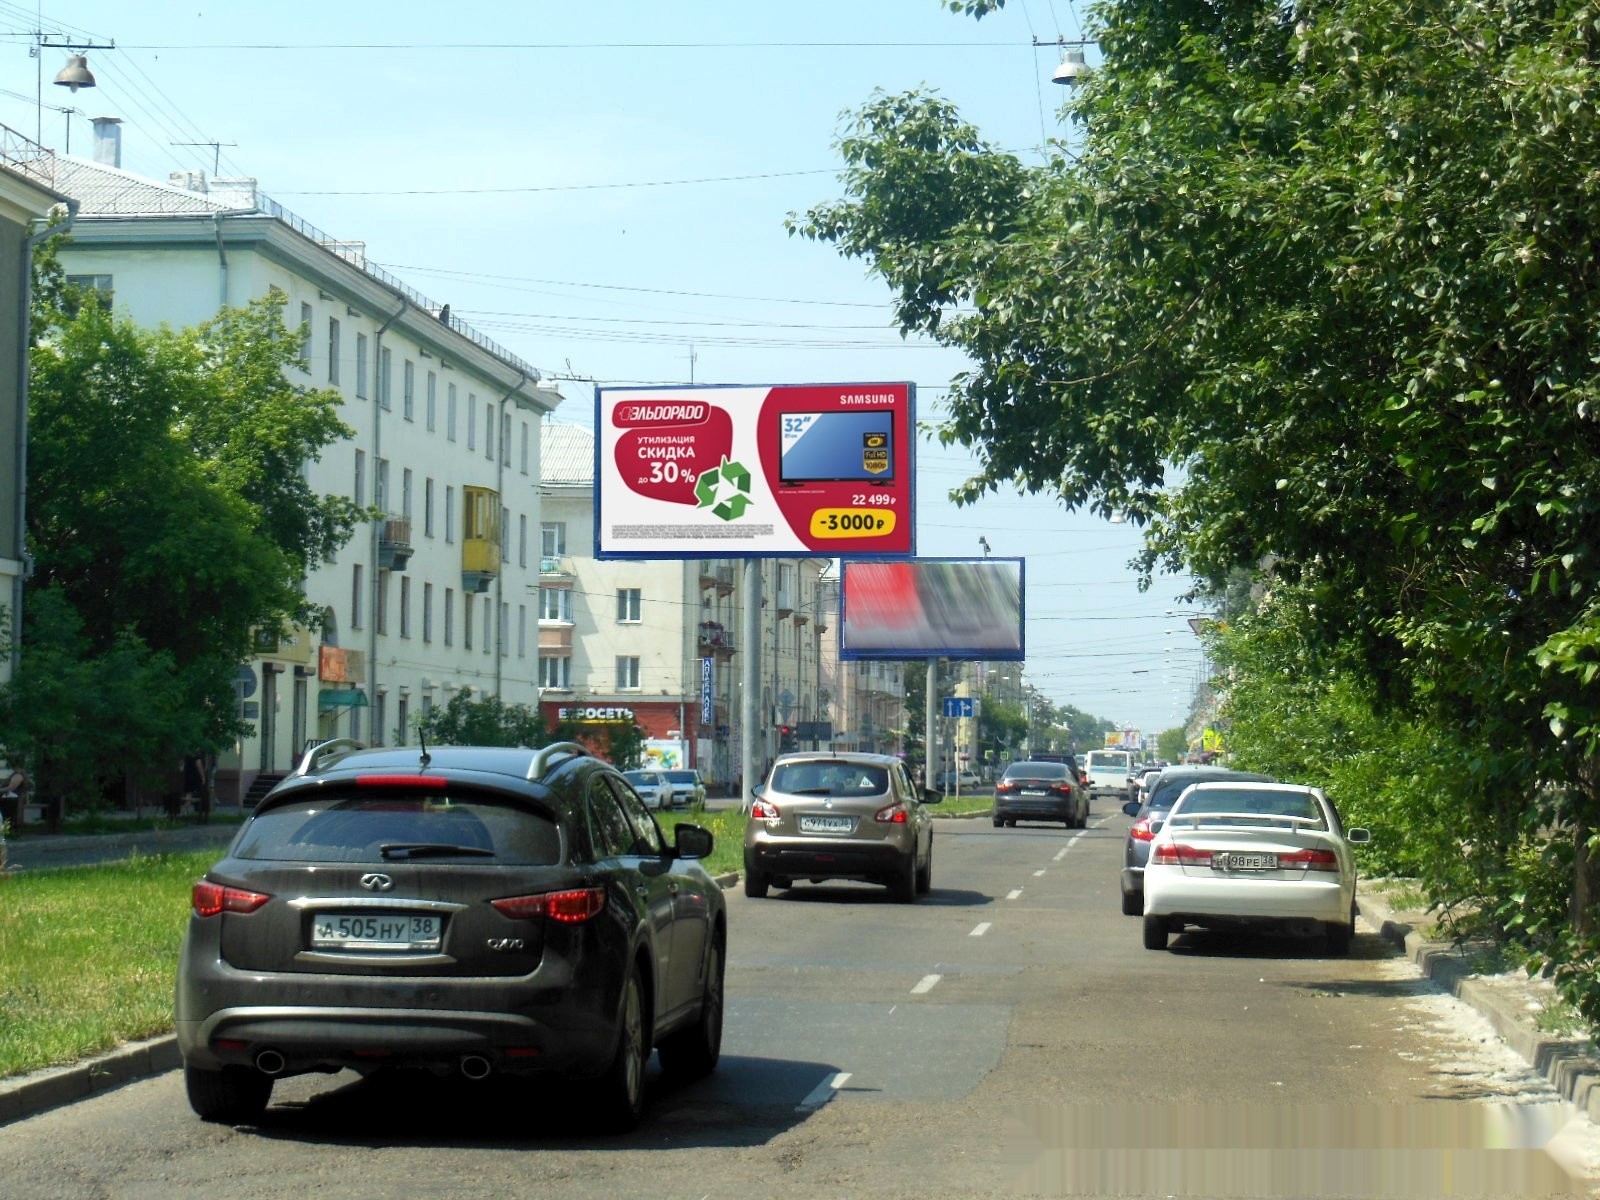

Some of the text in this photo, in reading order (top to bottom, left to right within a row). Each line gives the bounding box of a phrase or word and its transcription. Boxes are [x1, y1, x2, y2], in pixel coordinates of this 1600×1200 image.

[840, 393, 895, 405] SAMSUNG
[637, 435, 695, 444] УТИЛИЗАЦИЯ
[637, 446, 696, 461] СКИДКА
[637, 477, 648, 485] до
[558, 707, 634, 720] ЕРОСЕТЬ
